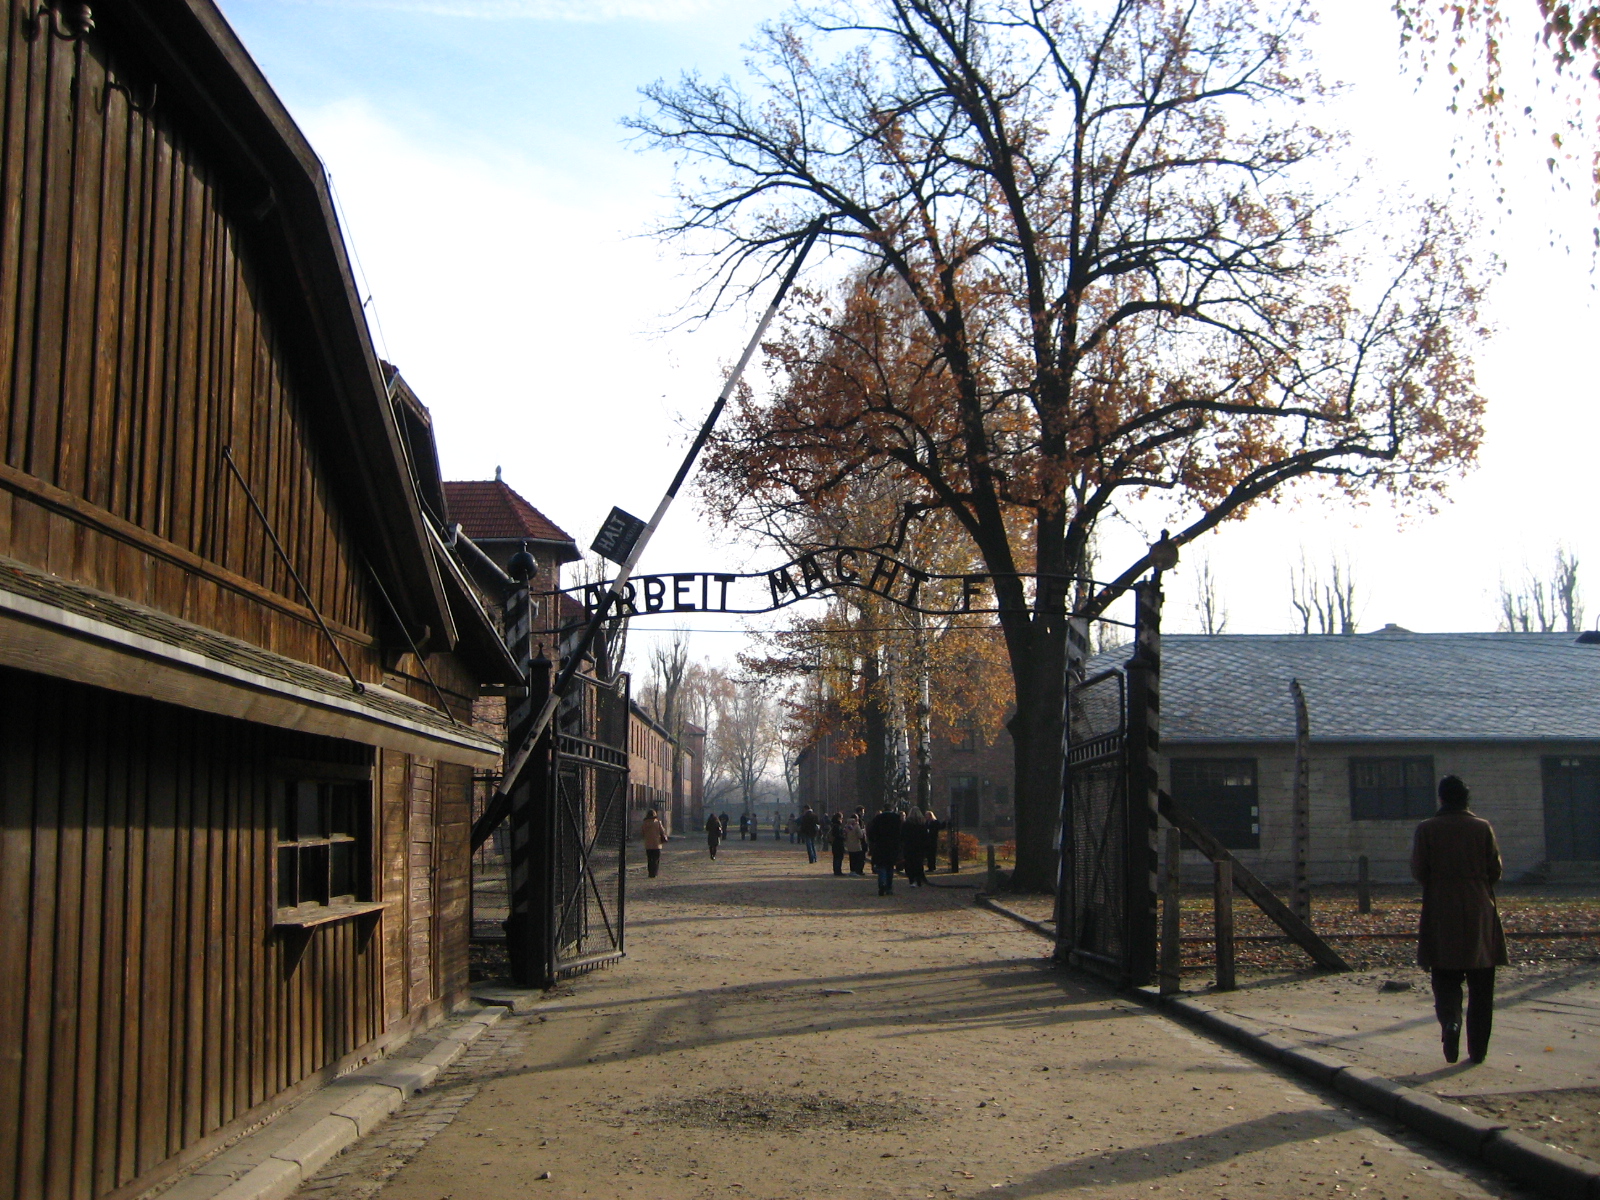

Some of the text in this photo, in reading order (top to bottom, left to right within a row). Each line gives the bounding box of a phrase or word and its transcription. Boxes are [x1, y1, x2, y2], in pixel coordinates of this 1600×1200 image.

[598, 514, 627, 552] HALT
[584, 574, 736, 620] ARBEIT
[768, 549, 929, 609] MACHT
